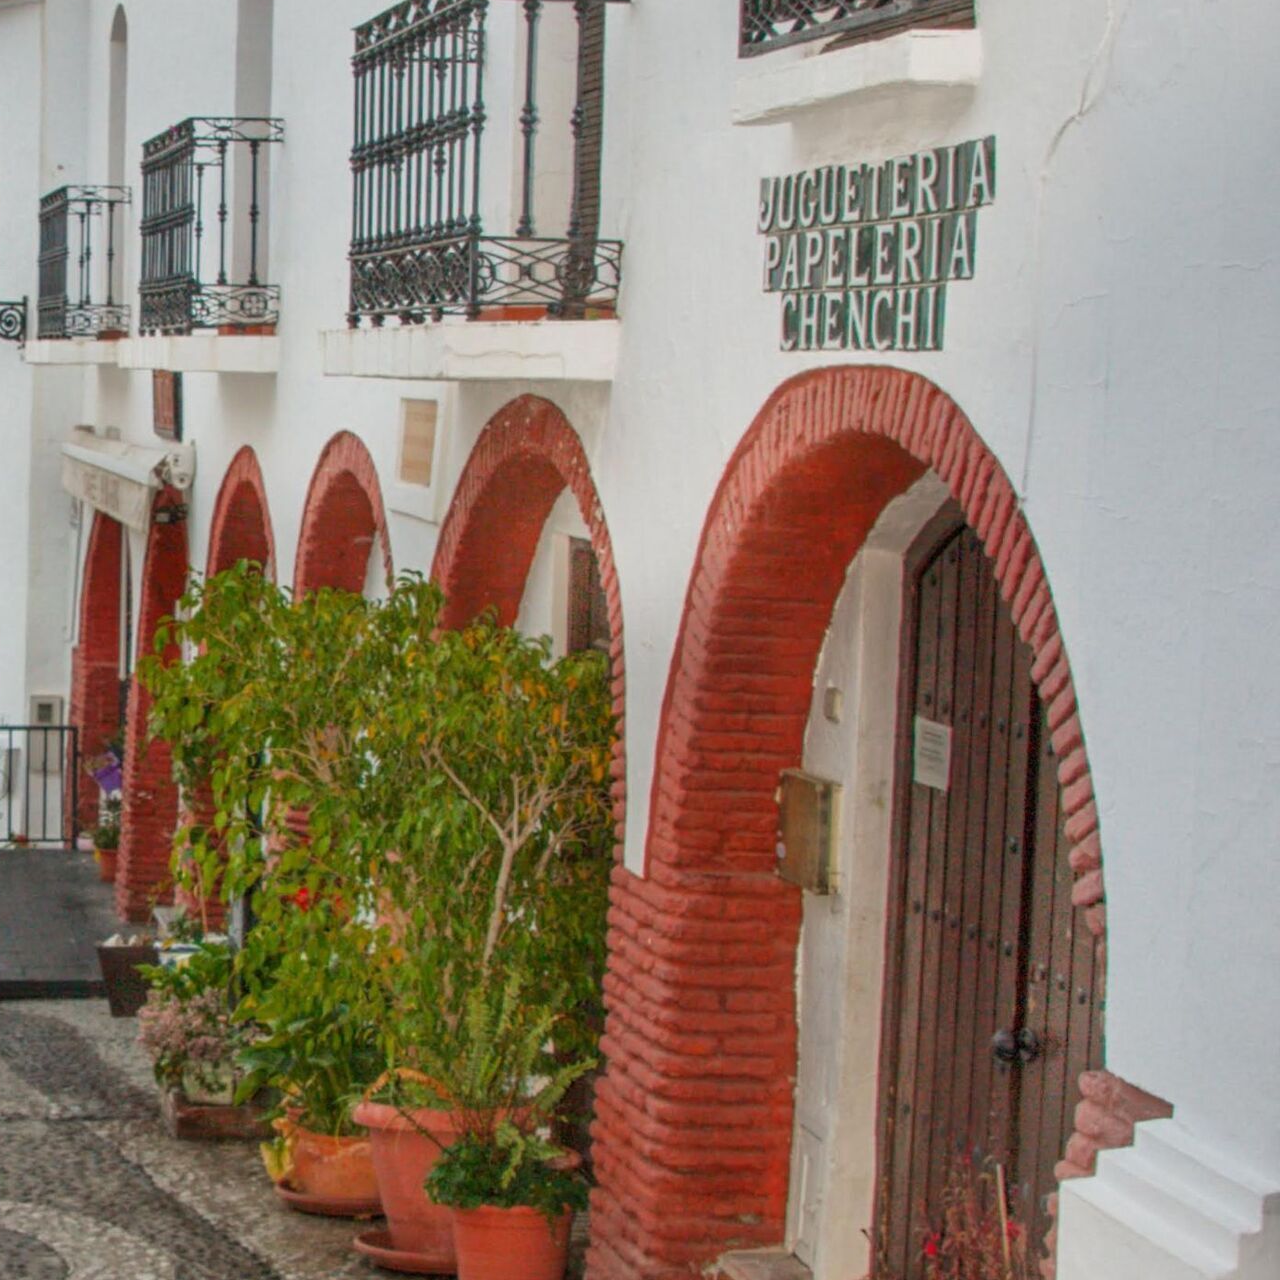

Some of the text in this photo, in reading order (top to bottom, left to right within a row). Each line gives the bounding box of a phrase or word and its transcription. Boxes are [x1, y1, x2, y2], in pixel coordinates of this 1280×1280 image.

[758, 139, 991, 232] JUGUETERIA
[764, 214, 971, 291] PAPELERIA
[780, 285, 937, 350] CHENCHI
